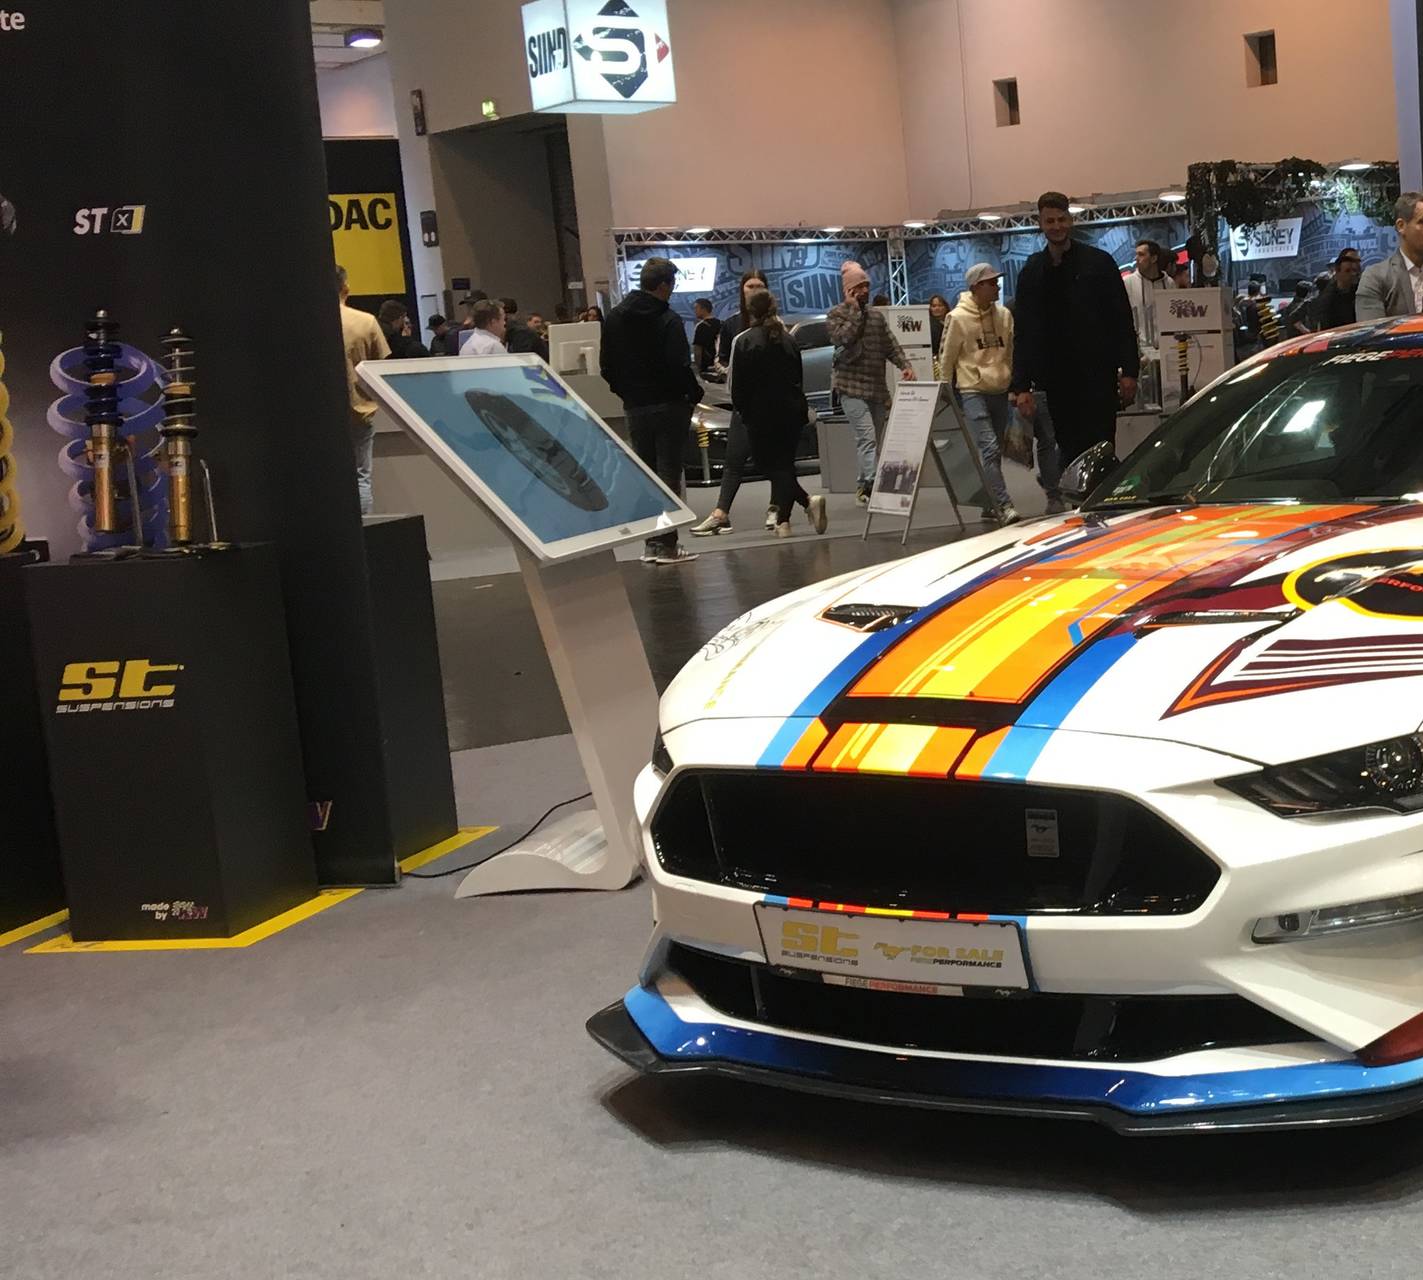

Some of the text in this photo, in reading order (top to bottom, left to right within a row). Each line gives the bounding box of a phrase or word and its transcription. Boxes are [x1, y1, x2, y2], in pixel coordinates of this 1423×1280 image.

[73, 207, 108, 235] ST
[1254, 228, 1294, 248] SIDNEY
[56, 699, 175, 713] SUSPENSIONS
[141, 902, 170, 912] made
[154, 911, 168, 921] by
[911, 945, 949, 958] FOR
[956, 947, 1004, 961] SALE
